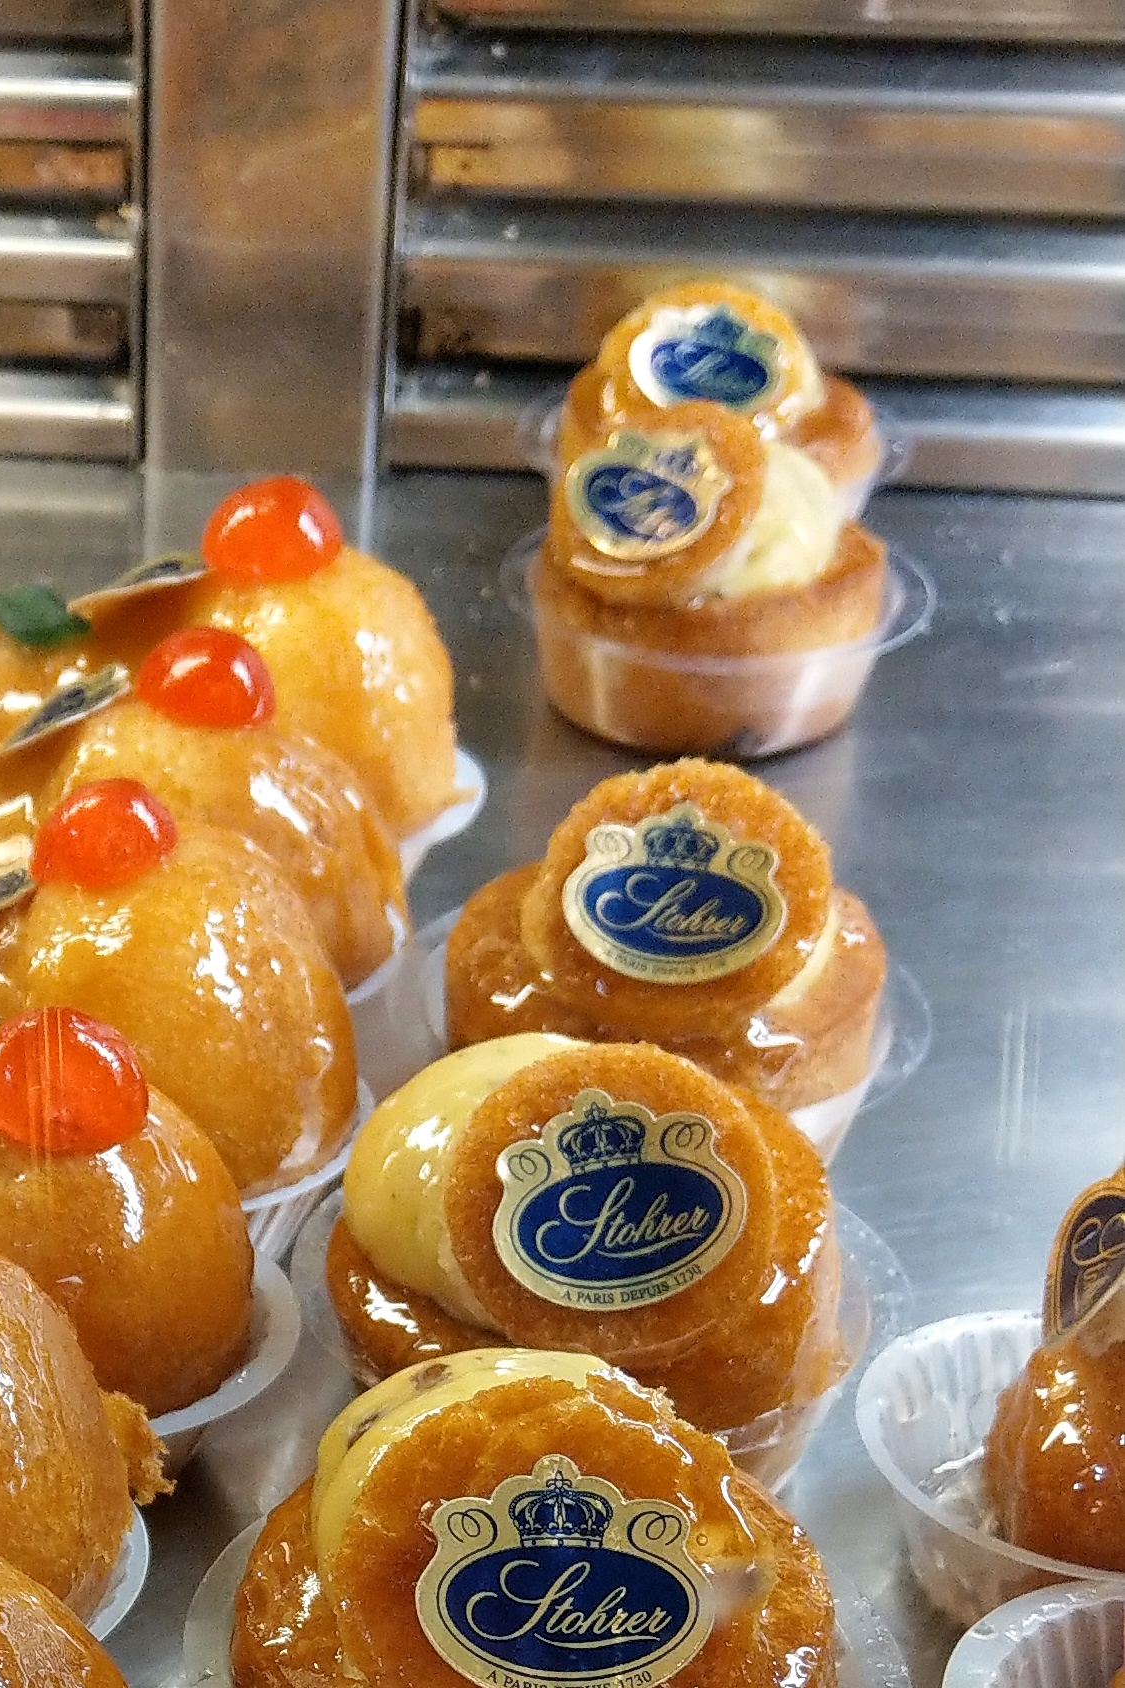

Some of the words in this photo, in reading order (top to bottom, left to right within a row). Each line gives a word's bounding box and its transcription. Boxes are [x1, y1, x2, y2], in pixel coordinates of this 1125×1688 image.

[535, 1176, 711, 1264] Stohrer
[577, 1293, 615, 1304] PARIS
[620, 1281, 671, 1303] DEPUIS
[466, 1559, 672, 1642] Stohrer
